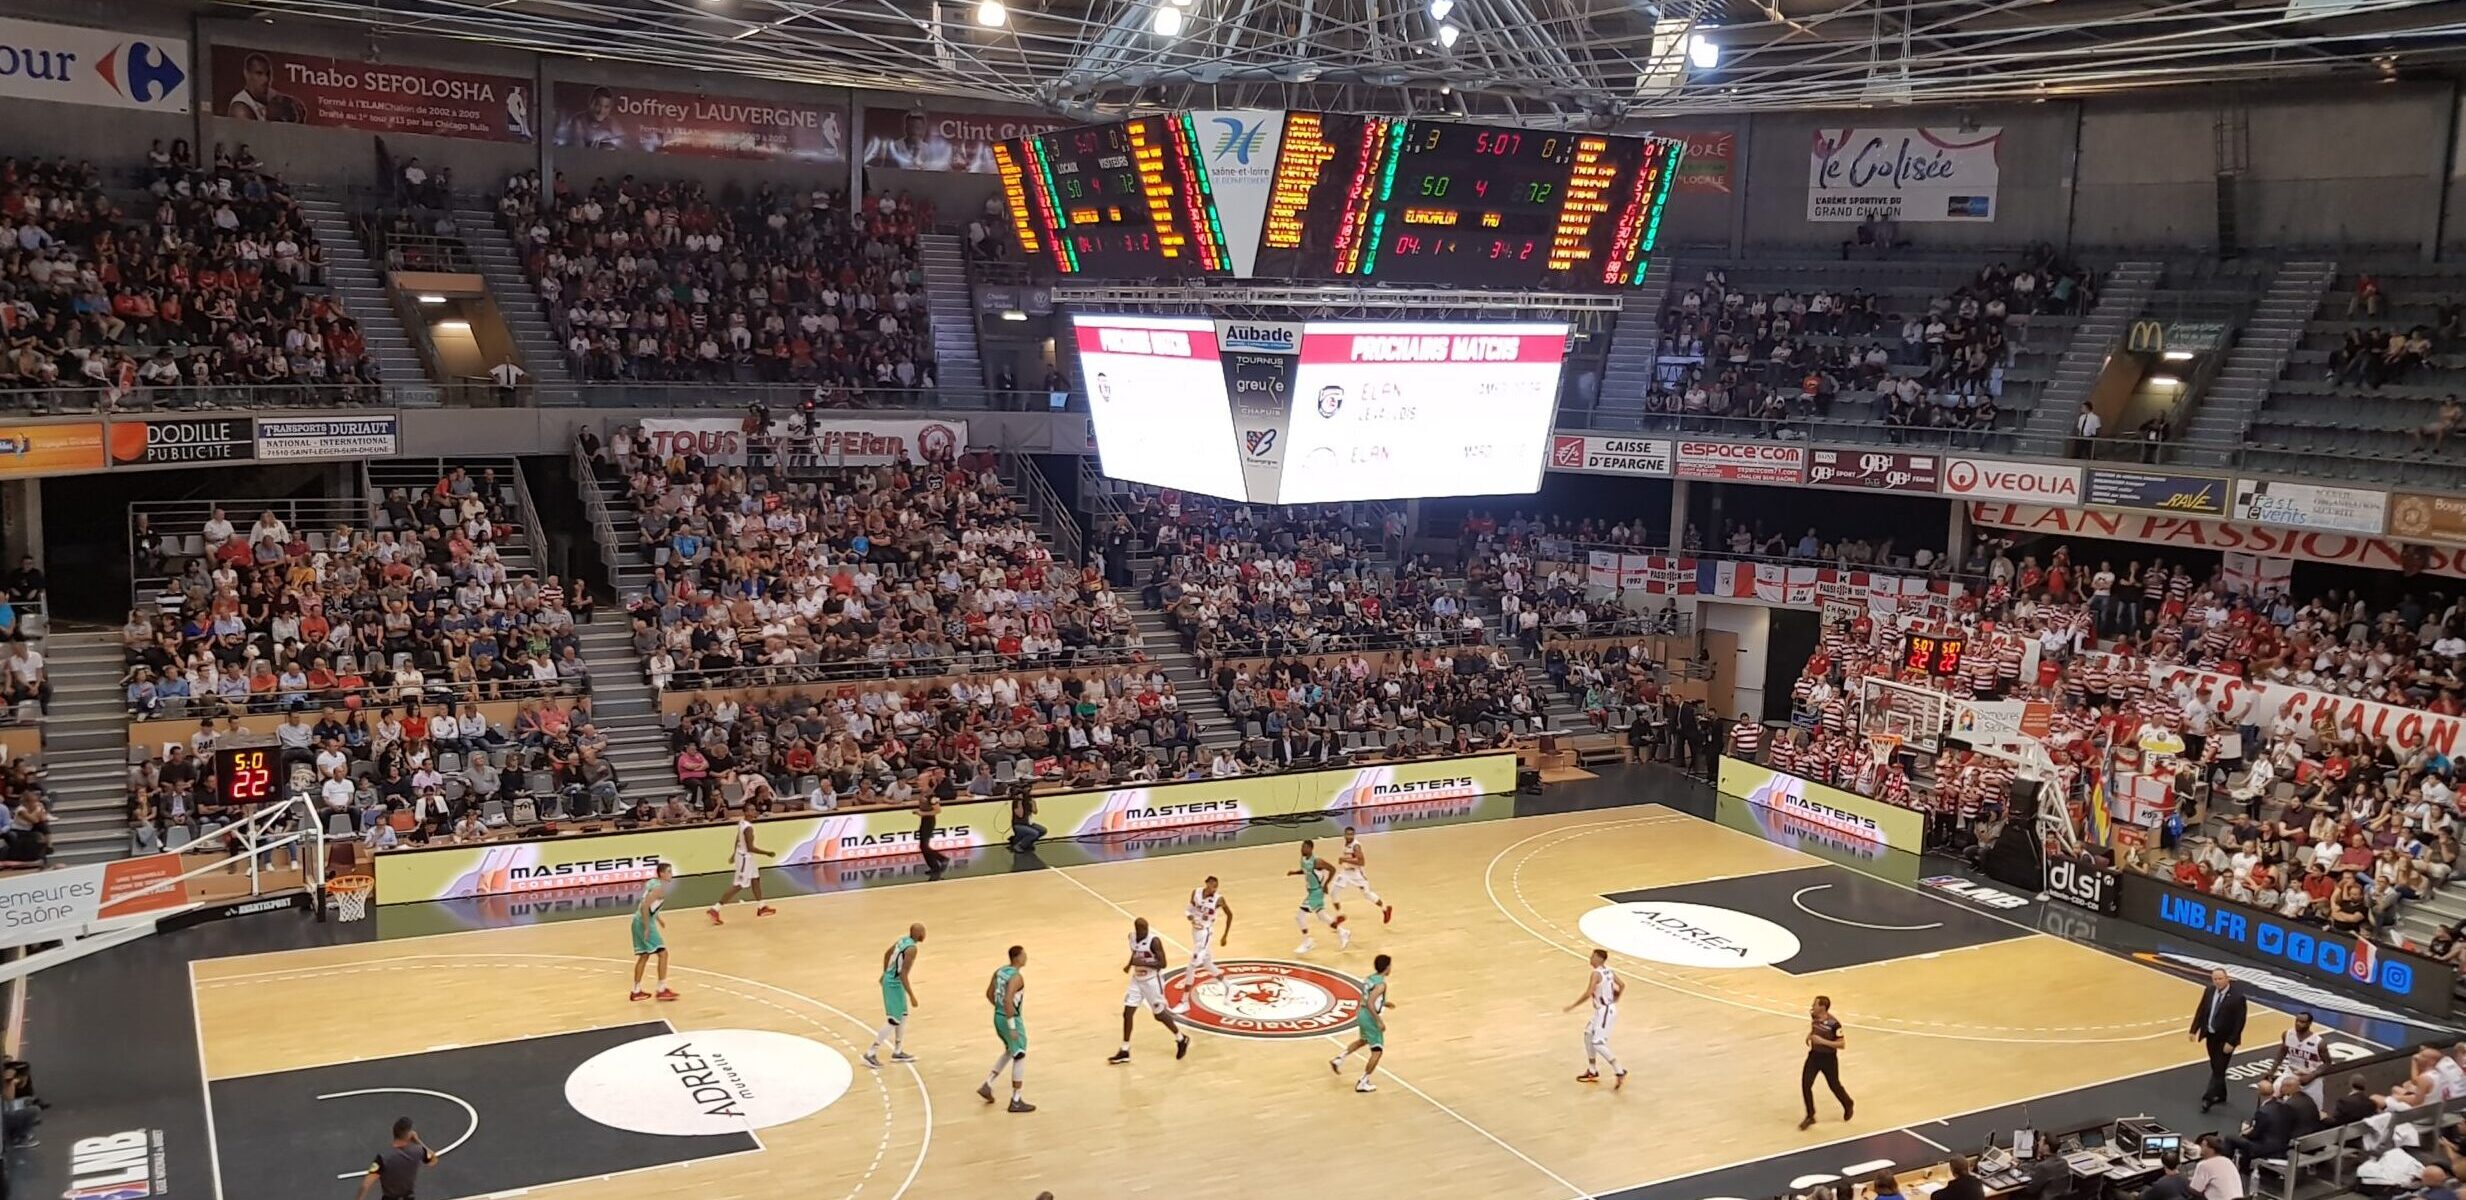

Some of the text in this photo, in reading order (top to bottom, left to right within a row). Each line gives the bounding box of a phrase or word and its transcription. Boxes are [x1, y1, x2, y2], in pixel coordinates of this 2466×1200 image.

[285, 63, 495, 103] Thabo SEFOLOSHA
[429, 106, 451, 118] 2002
[618, 96, 818, 128] Joffrey LAUVERGNE
[435, 120, 468, 132] Chicago
[939, 120, 993, 141] Clint
[1426, 129, 1556, 158] 3 5:07 0
[1057, 155, 1128, 174] LOCAUX VISITEURS
[1211, 167, 1270, 177] saône-et-loire
[1819, 137, 1954, 189] le Colisée
[1421, 176, 1552, 203] 50 4 72
[1850, 196, 1888, 205] SPORTIVE
[1890, 196, 1902, 205] DU
[1815, 206, 1901, 217] GRAND CHALON
[1226, 325, 1293, 343] Aubade
[1236, 356, 1284, 366] TOURNUS
[1236, 377, 1285, 404] greuze
[147, 422, 230, 443] DODILLE
[264, 422, 389, 437] TRANSPORTS DURIAUT
[147, 444, 232, 462] PUBLICITE
[266, 437, 389, 448] NATIONAL INTERNATIONAL
[652, 431, 739, 456] TOUS
[1605, 441, 1652, 453] CAISSE
[1588, 456, 1665, 471] D'EPARGNE
[1984, 471, 2077, 495] VEOLIA
[2162, 484, 2214, 508] RAVE
[2247, 507, 2307, 523] events
[1973, 500, 2122, 536] ELAN
[2140, 512, 2402, 566] PASSION
[1910, 650, 1957, 671] 22 22
[234, 769, 268, 797] 22
[1374, 776, 1472, 795] MASTER'S
[1126, 800, 1238, 820] MASTER'S
[1786, 794, 1876, 829] MASTER'S
[841, 825, 970, 847] MASTER'S
[510, 855, 660, 879] MASTER'S
[2050, 861, 2101, 902] dlsi
[6, 901, 72, 928] Saône
[2160, 893, 2247, 943] LNB.FR
[1631, 908, 1748, 957] ADREA
[1220, 999, 1359, 1032] ELANChalon
[664, 1042, 746, 1117] ADREA
[72, 1129, 149, 1190] LNB
